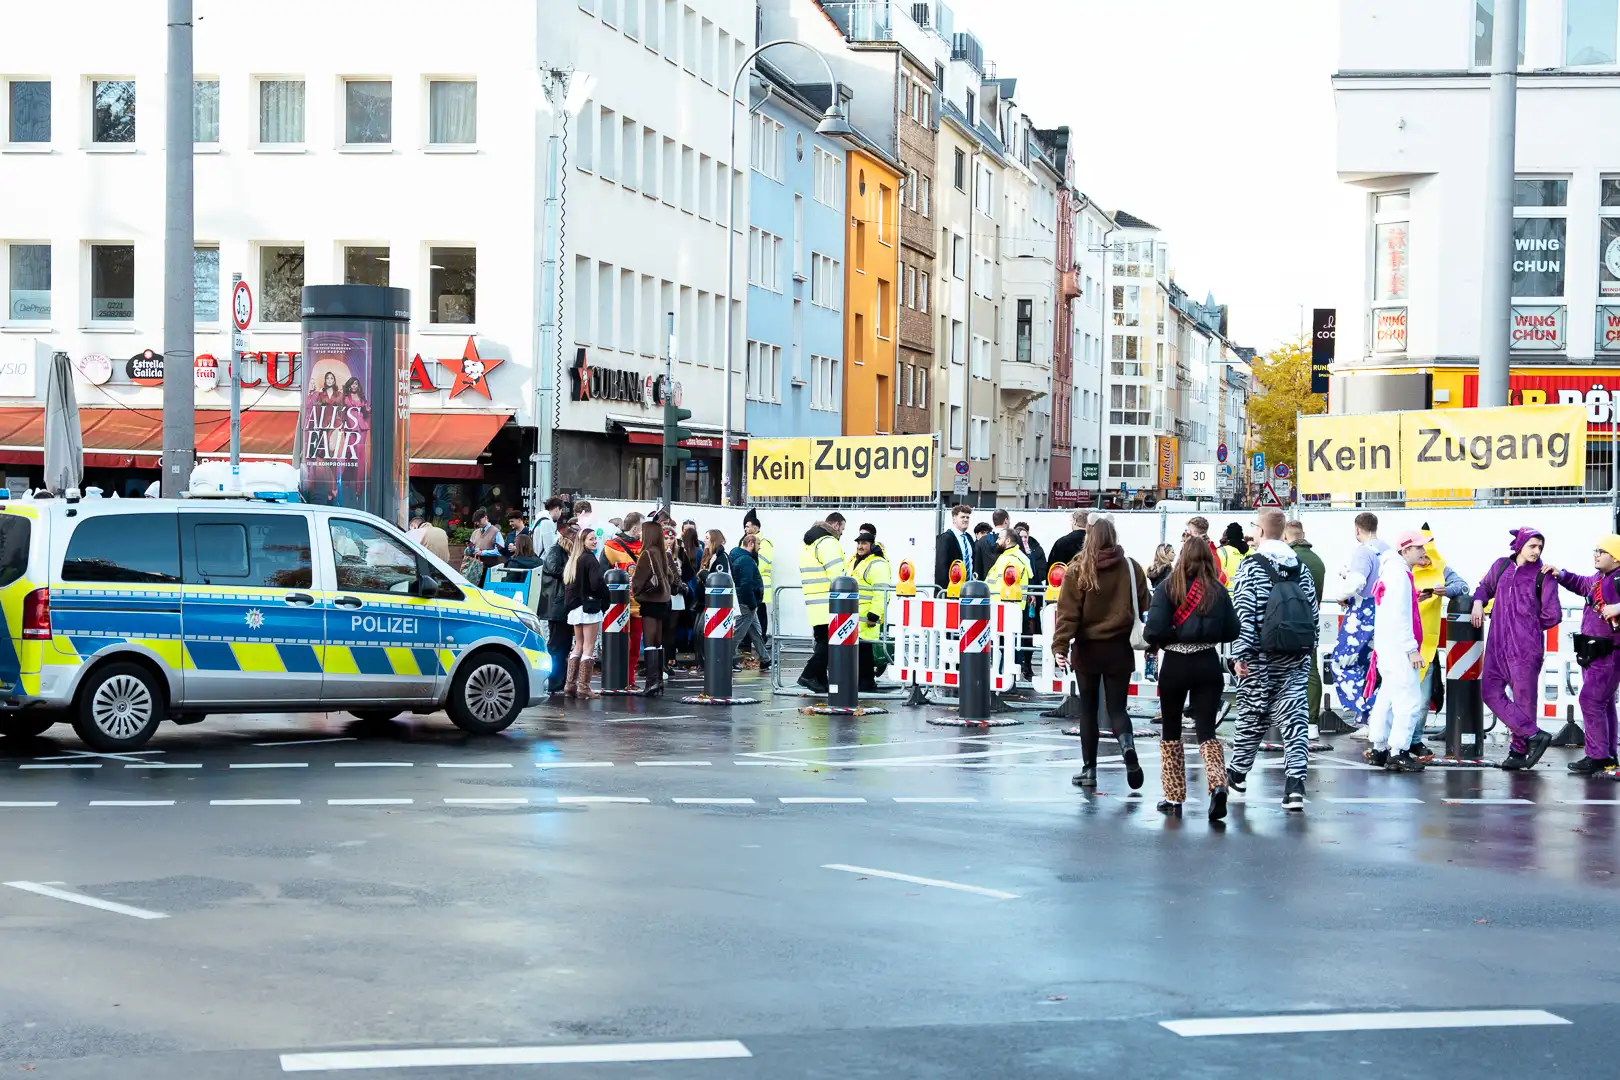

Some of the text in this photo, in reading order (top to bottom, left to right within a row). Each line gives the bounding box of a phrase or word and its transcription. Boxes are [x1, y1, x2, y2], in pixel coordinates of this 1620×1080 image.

[1515, 239, 1560, 251] WING
[1513, 260, 1560, 272] CHUN
[1515, 316, 1556, 327] WING
[1512, 329, 1557, 341] CHUN
[132, 360, 164, 369] Estrella
[133, 368, 163, 378] Galicia
[196, 369, 215, 379] früh
[591, 365, 645, 404] CUBANA
[306, 405, 361, 430] ALL'S
[305, 430, 361, 460] FAIR
[1308, 428, 1570, 472] Kein Zugang
[752, 440, 929, 480] Kein Zugang
[1193, 471, 1206, 481] 30
[1055, 490, 1064, 498] City
[351, 615, 419, 634] POLIZEI
[837, 618, 856, 640] FFR
